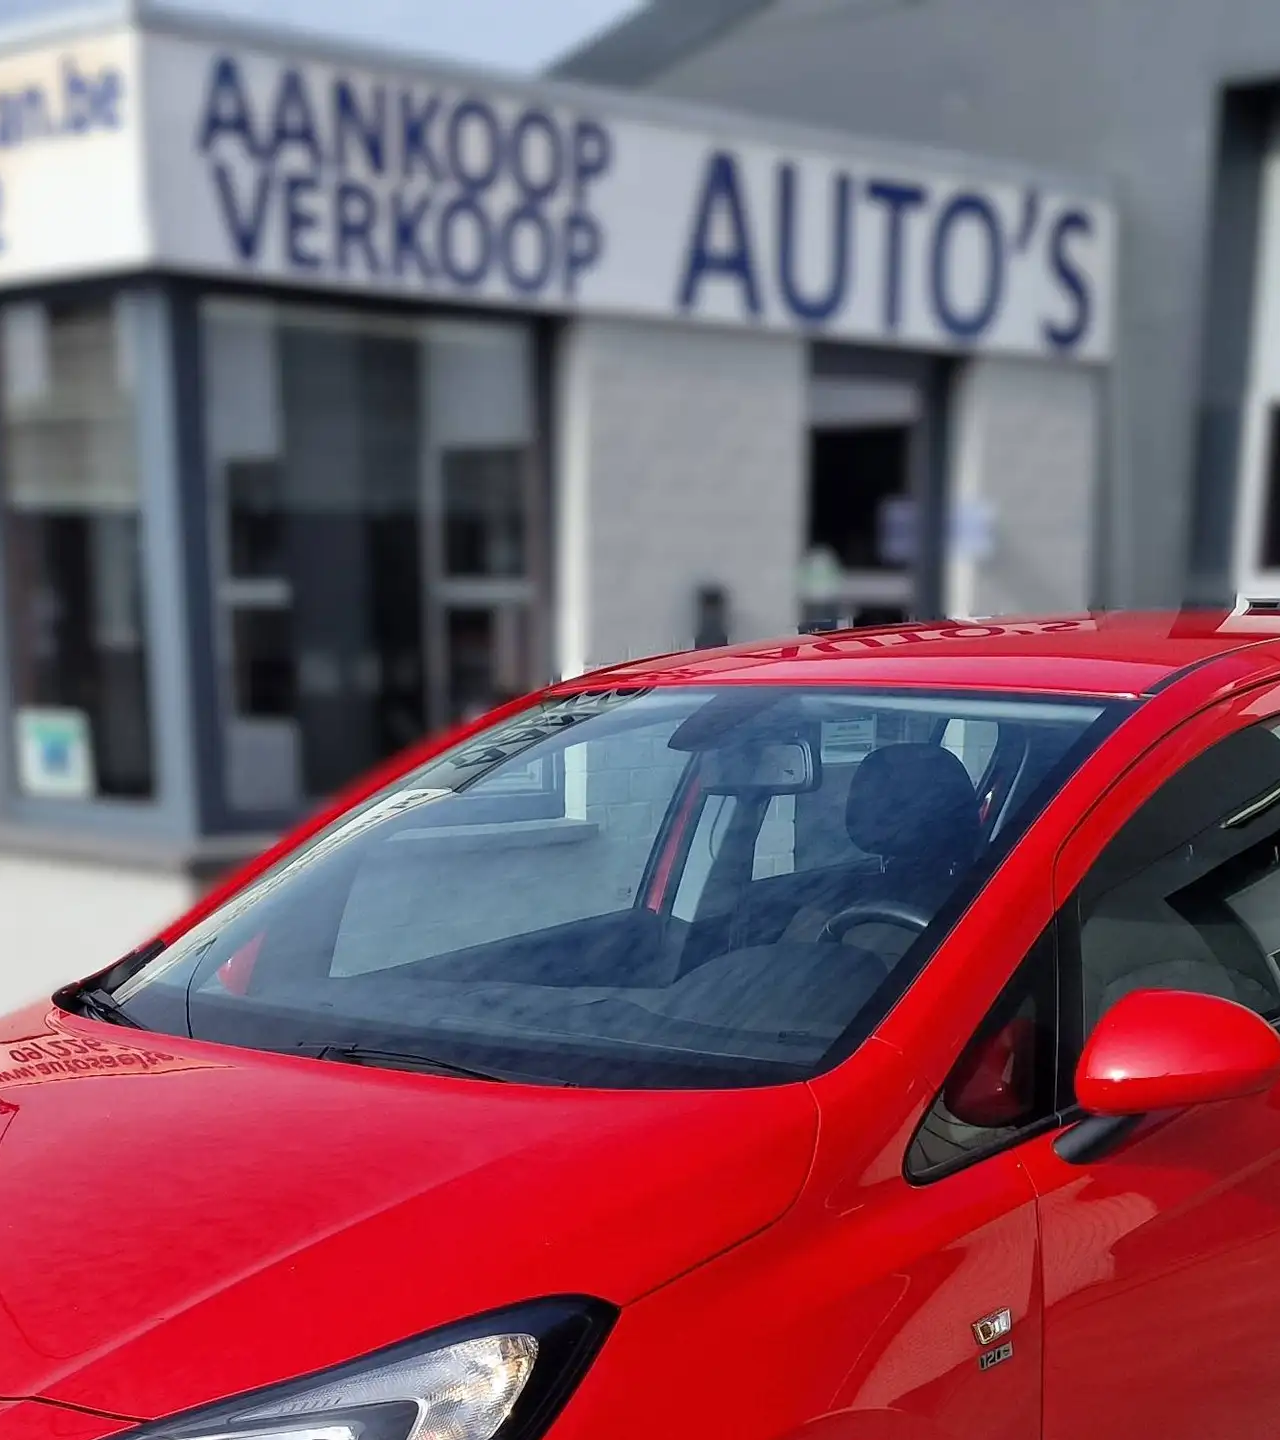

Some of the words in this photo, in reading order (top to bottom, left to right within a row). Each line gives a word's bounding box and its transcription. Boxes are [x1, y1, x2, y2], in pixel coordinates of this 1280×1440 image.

[199, 56, 612, 199] AANKOOP
[214, 160, 605, 295] VERKOOP
[677, 151, 1096, 350] AUTO'S
